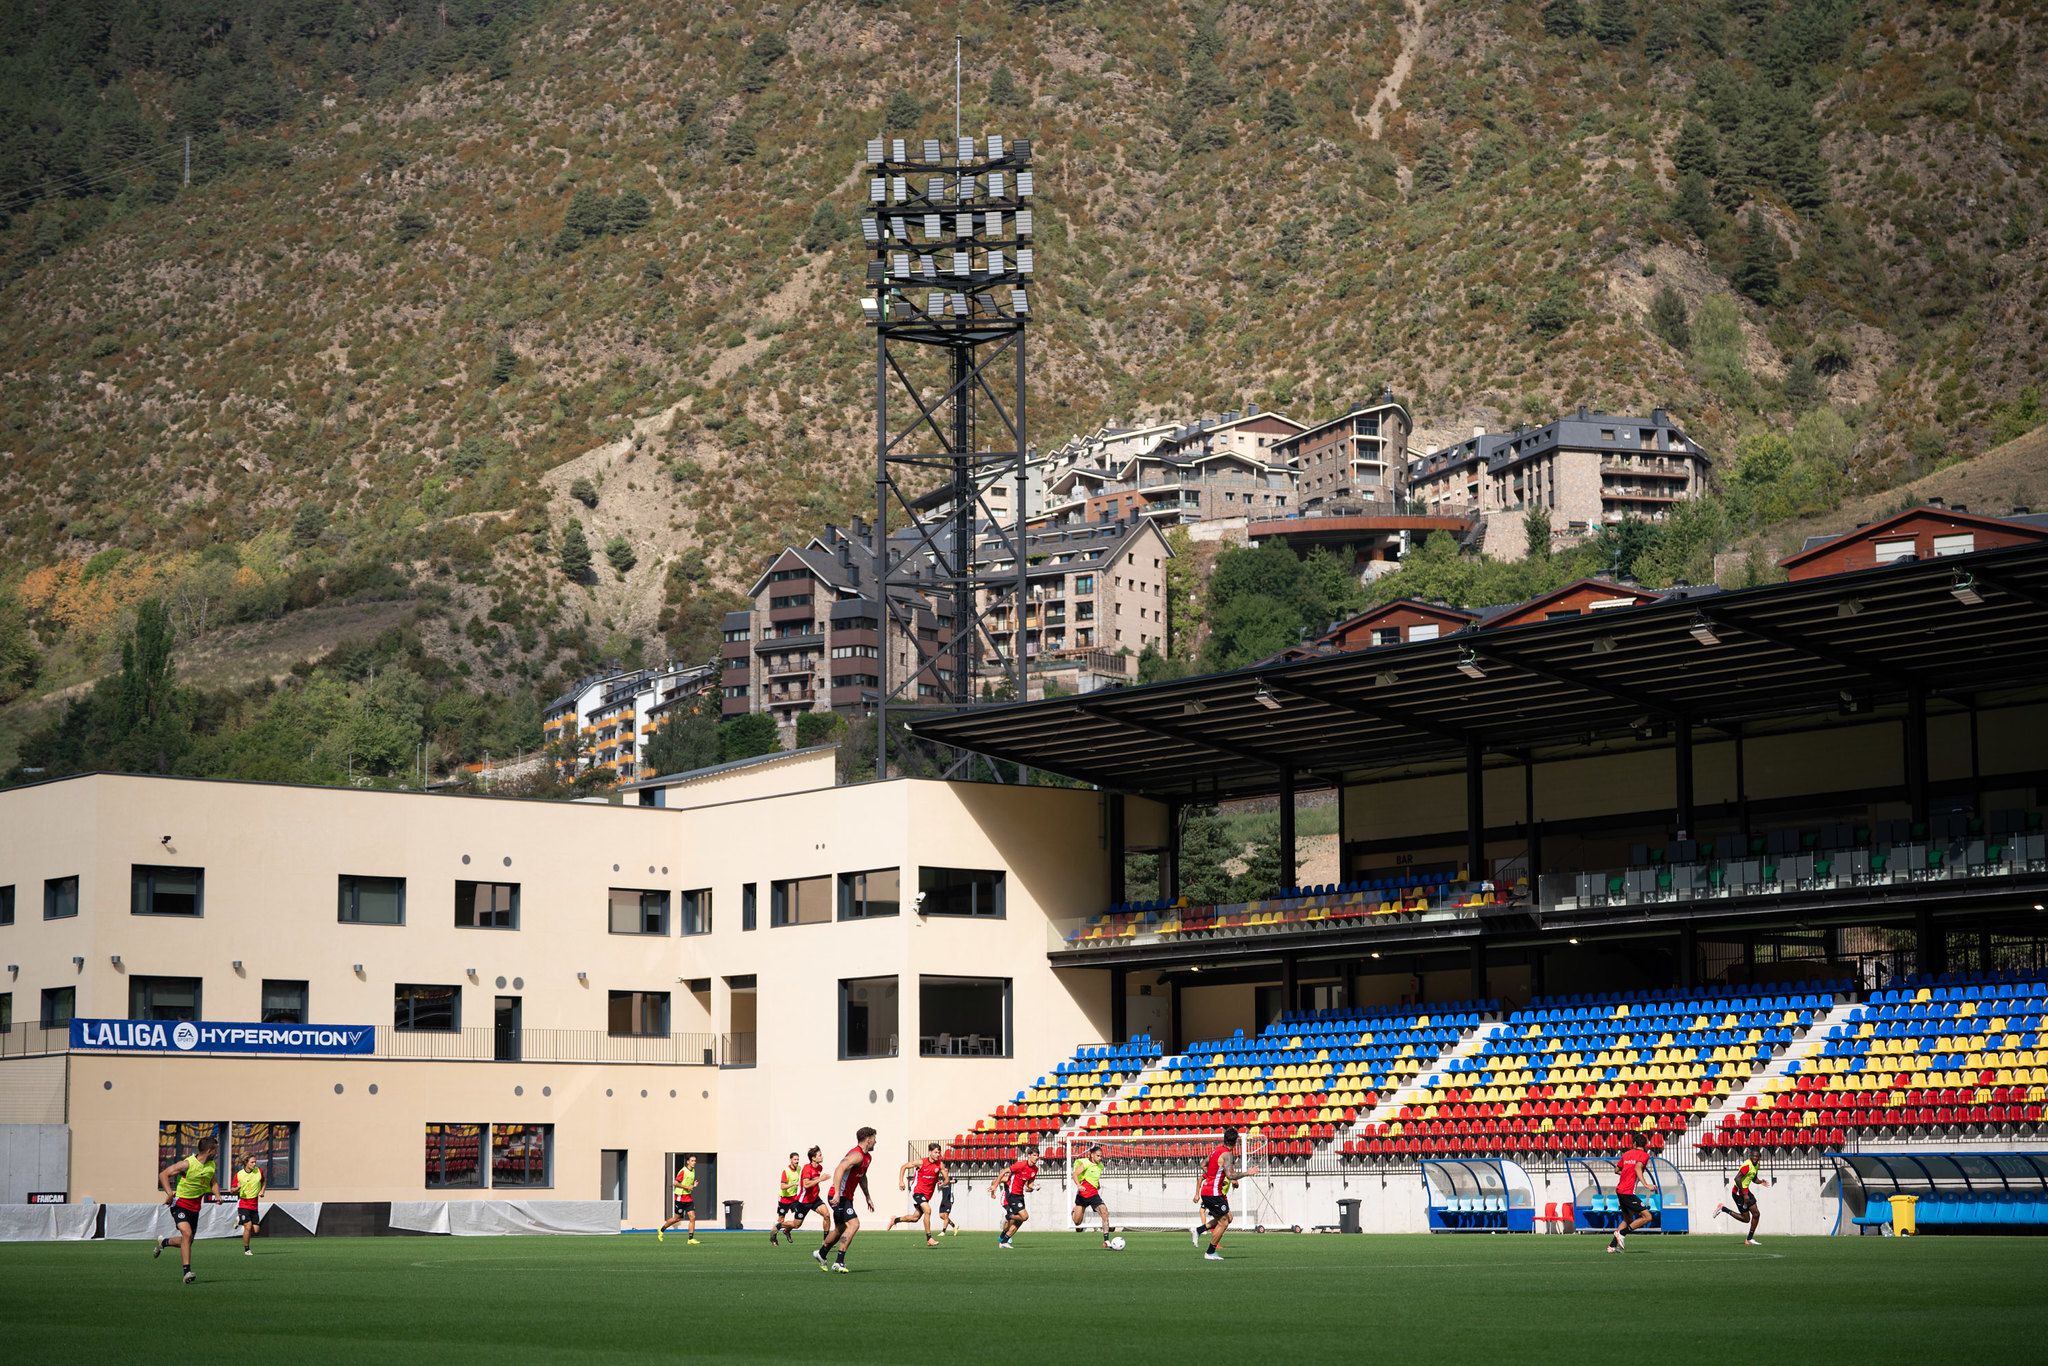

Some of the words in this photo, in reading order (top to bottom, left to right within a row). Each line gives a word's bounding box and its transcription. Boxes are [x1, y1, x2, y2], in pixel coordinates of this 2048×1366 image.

[1397, 854, 1413, 865] BAR
[83, 1022, 168, 1047] LALIGA
[178, 1029, 193, 1037] EA
